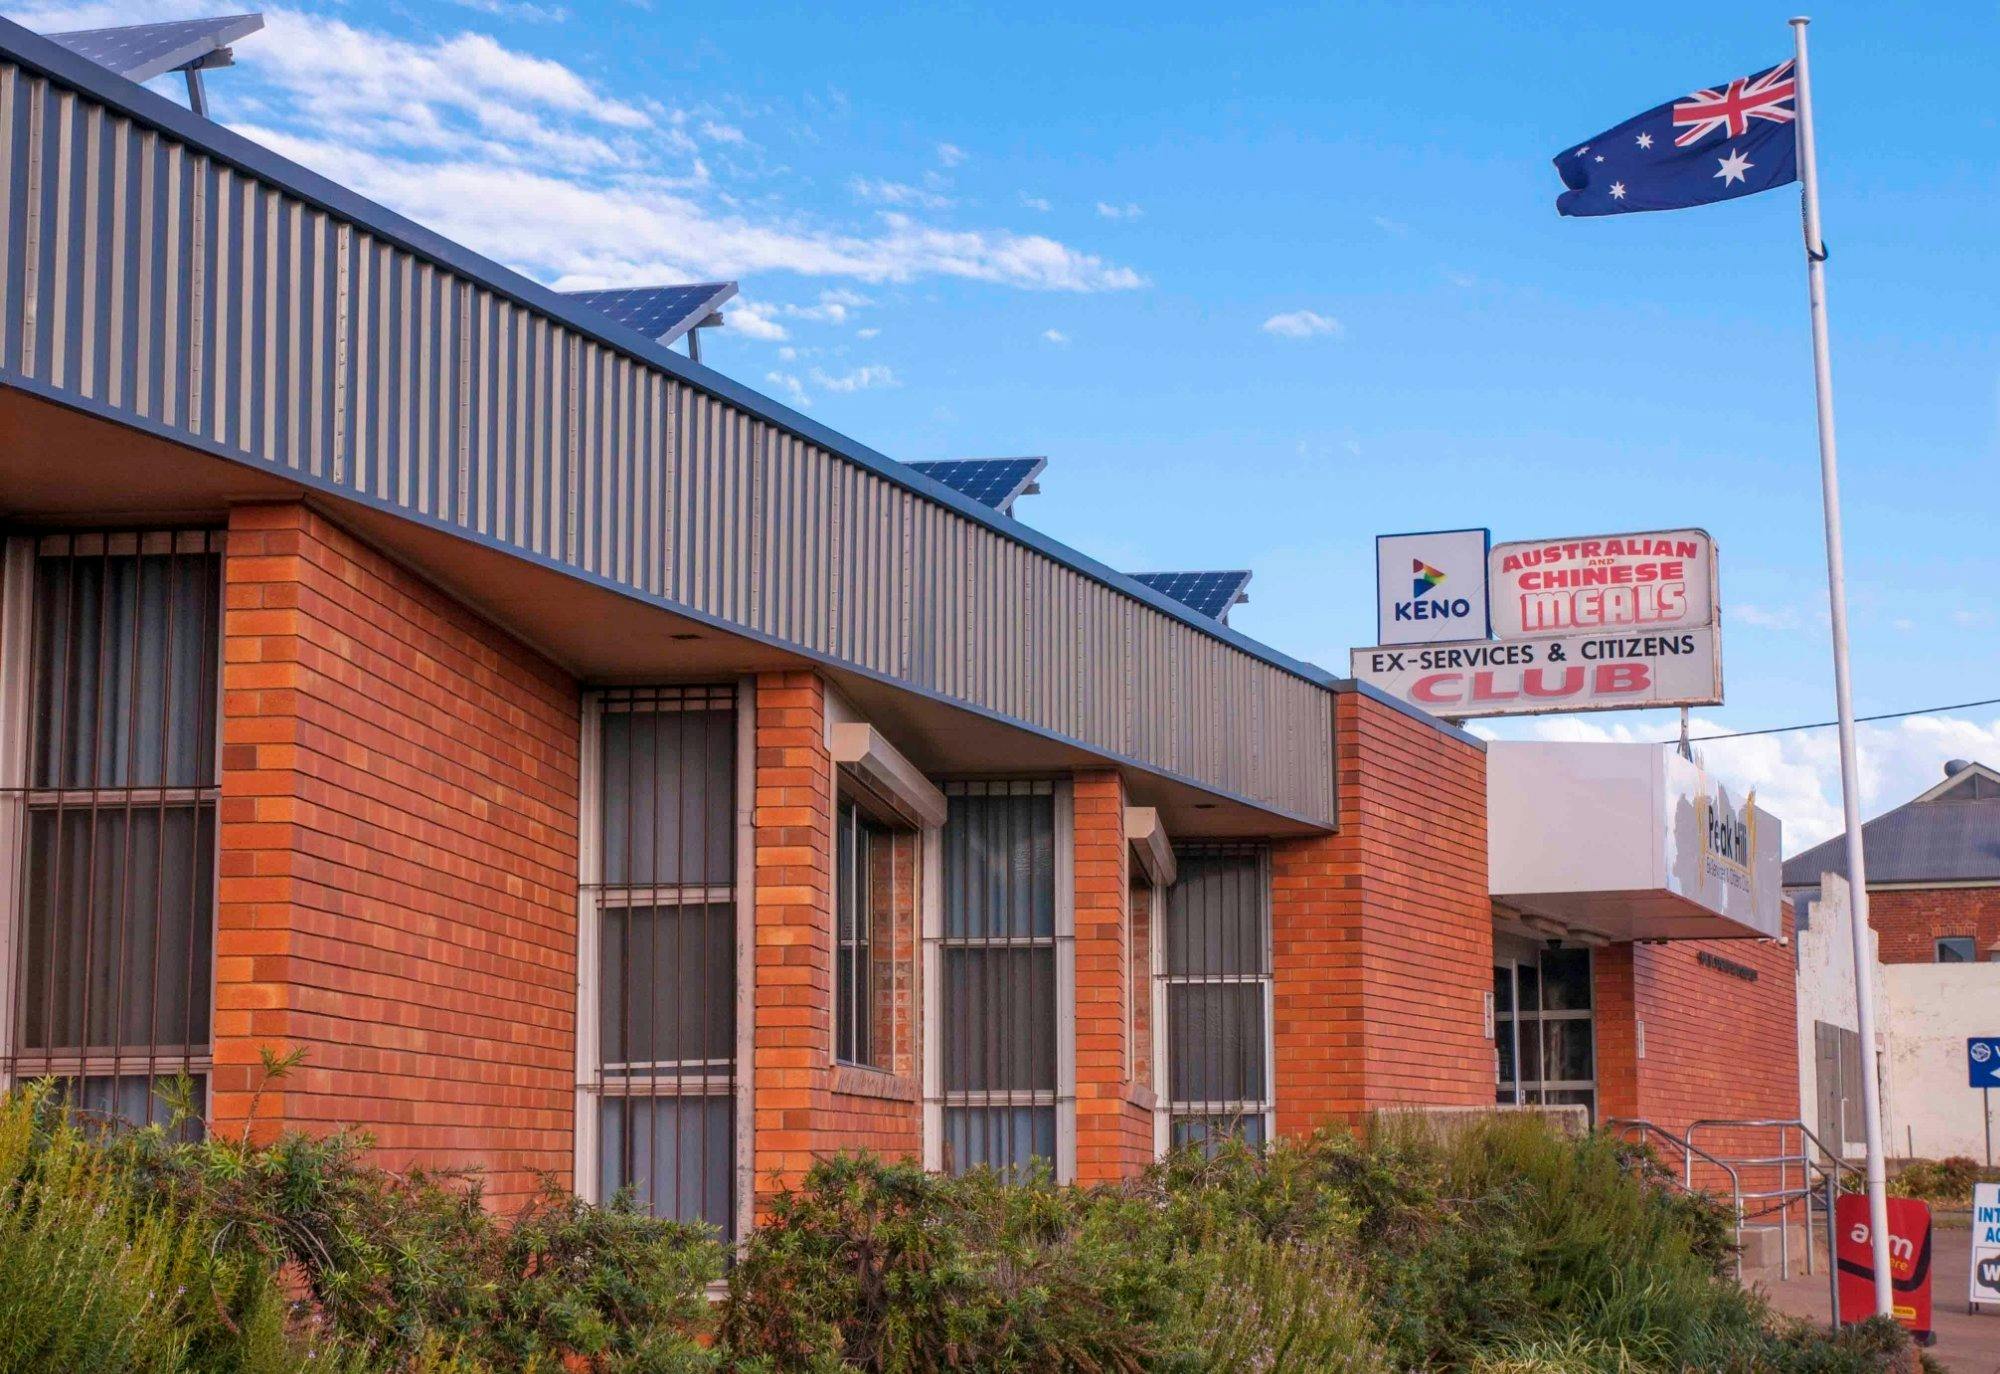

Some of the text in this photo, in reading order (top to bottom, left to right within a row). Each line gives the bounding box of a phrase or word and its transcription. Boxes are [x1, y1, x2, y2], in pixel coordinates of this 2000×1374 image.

[1502, 539, 1697, 573] AUSTRALIAN
[1588, 558, 1615, 567] AND
[1518, 561, 1684, 590] CHINESE
[1395, 598, 1470, 621] KENO
[1520, 582, 1687, 632] MEALS
[1372, 635, 1695, 672] EX-SERVICES & CITIZENS
[1411, 663, 1652, 702] CLUB
[1709, 805, 1733, 860] Peak
[1850, 1223, 1913, 1260] am
